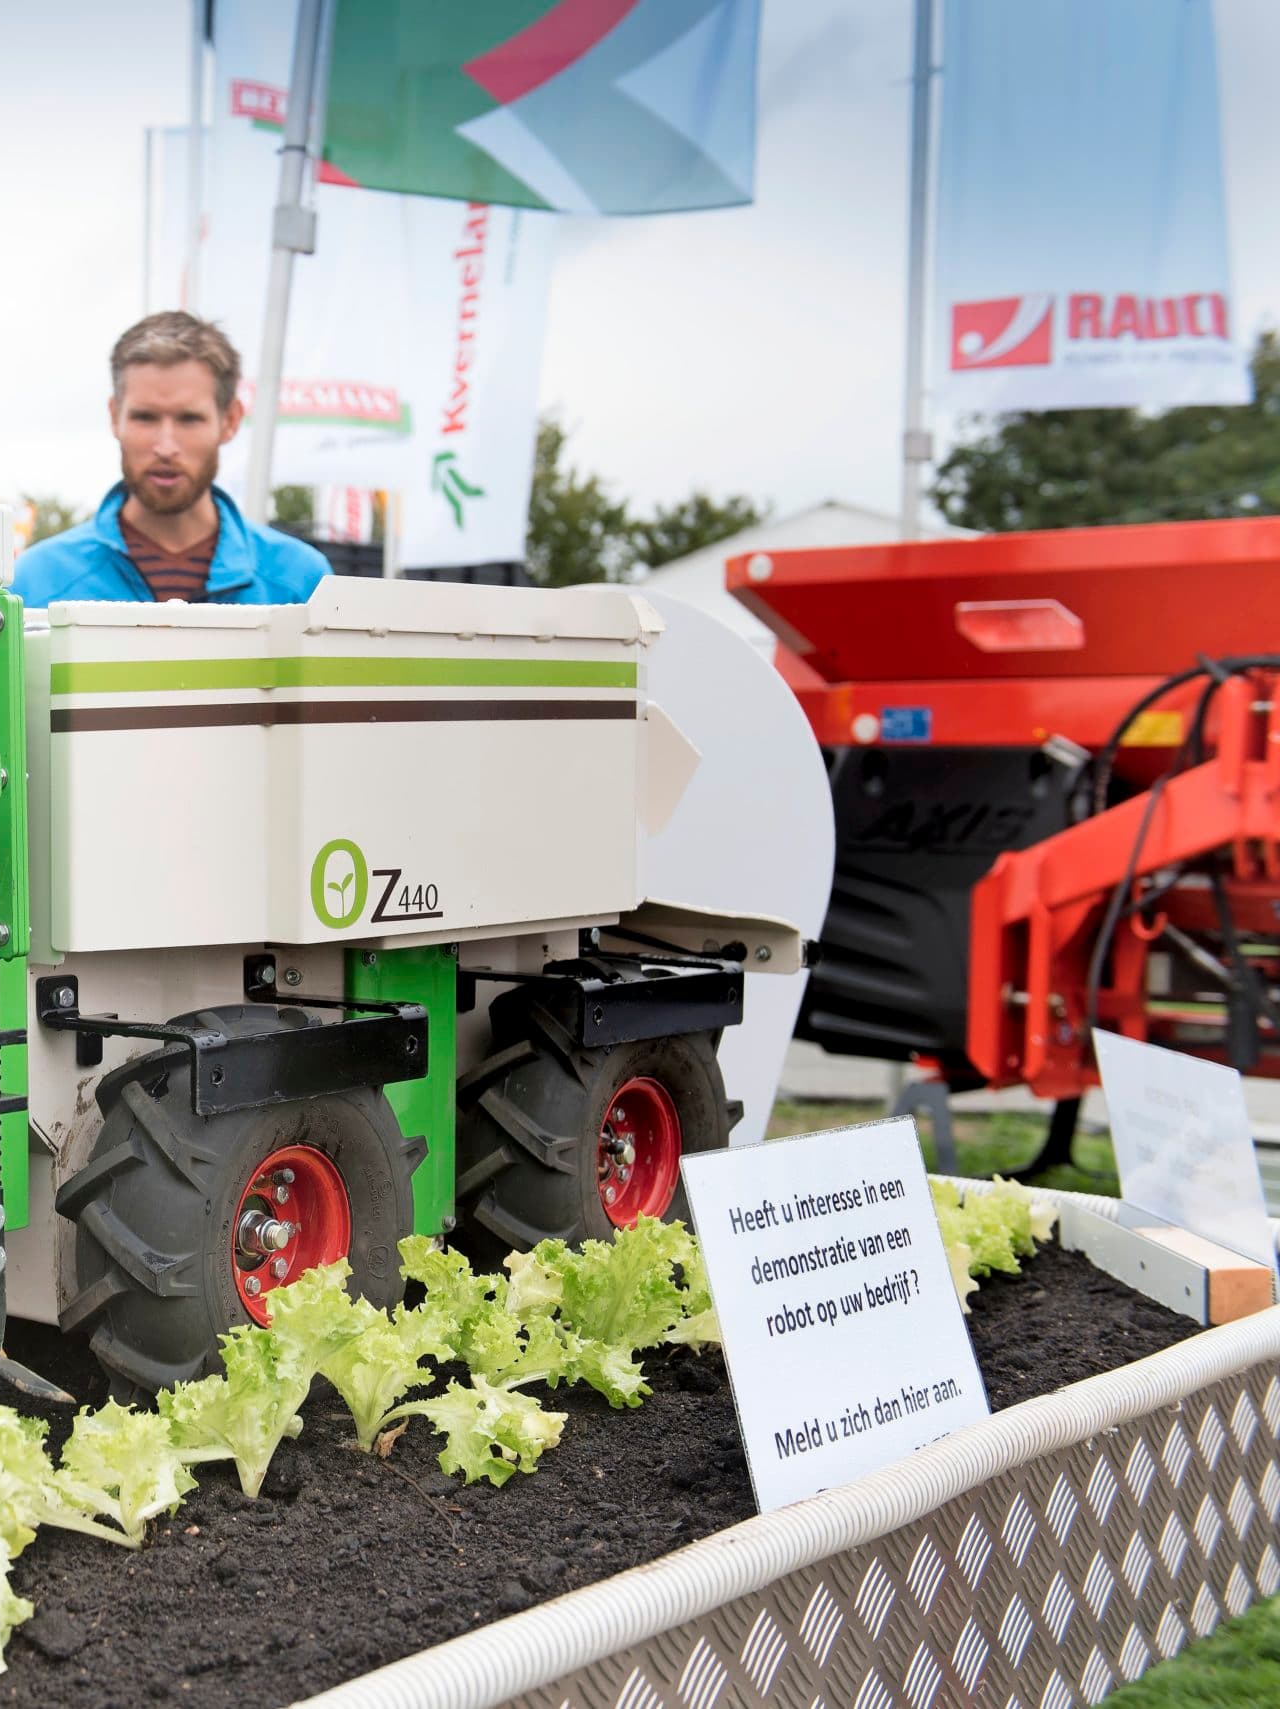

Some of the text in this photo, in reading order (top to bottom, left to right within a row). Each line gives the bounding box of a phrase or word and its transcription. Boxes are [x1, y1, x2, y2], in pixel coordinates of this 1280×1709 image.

[729, 1179, 905, 1235] Heeft u interesse in een
[751, 1227, 912, 1285] demonstratie van een
[767, 1302, 815, 1337] robot
[817, 1299, 838, 1327] op
[840, 1292, 863, 1316] uw
[864, 1270, 911, 1309] bedrijf
[774, 1378, 962, 1460] Meld u zich dan hier aan.
